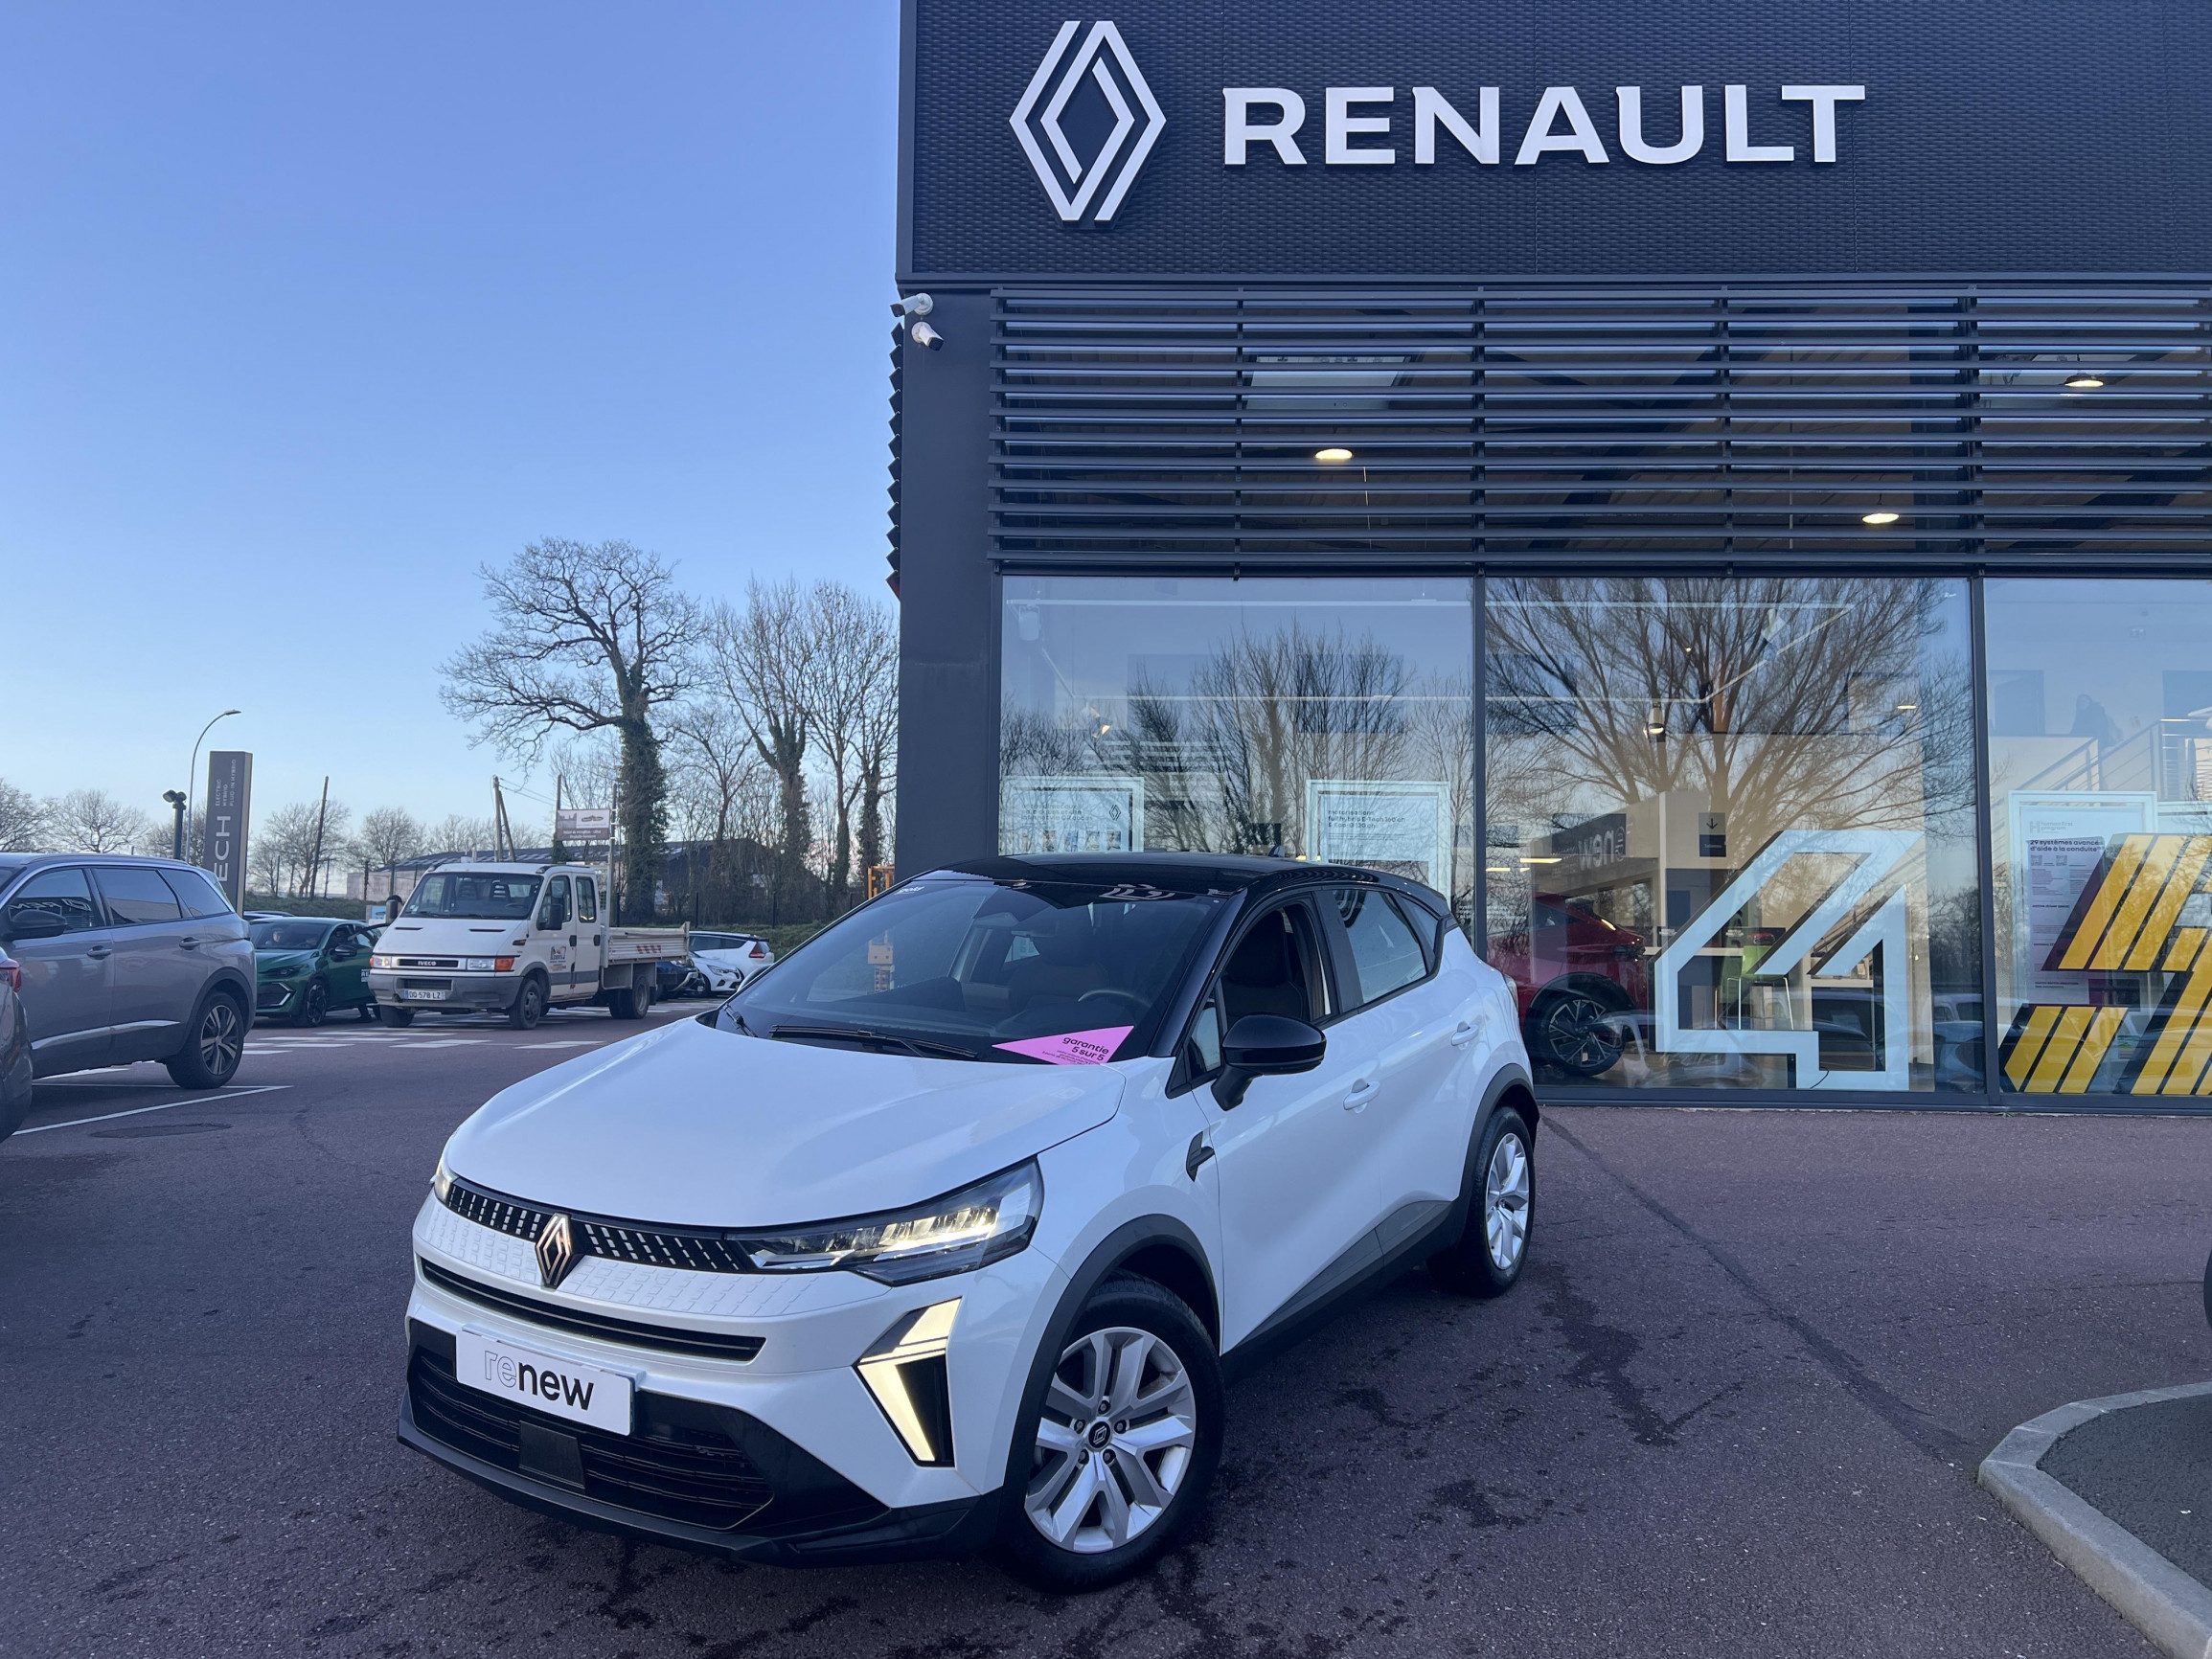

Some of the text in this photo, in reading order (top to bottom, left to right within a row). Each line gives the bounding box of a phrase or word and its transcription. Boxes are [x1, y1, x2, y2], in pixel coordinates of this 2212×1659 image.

[1222, 84, 1866, 166] RENAULT
[1062, 1037, 1109, 1055] garantie
[1079, 1049, 1098, 1058] sur
[484, 1350, 594, 1411] renew
